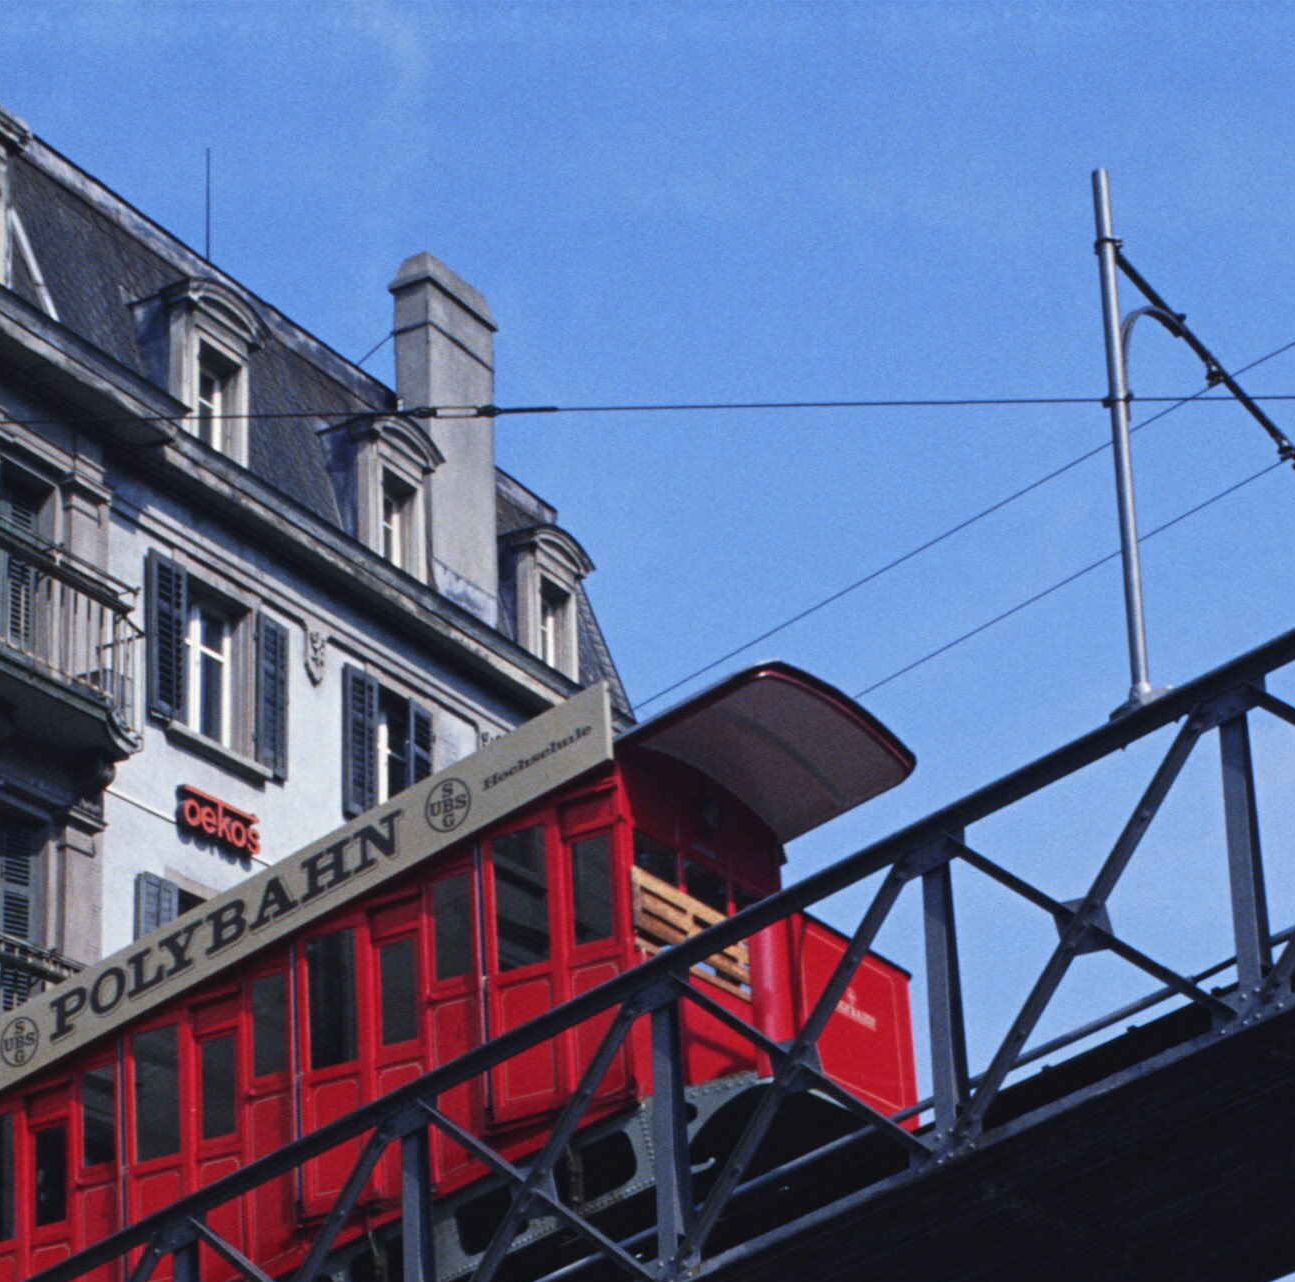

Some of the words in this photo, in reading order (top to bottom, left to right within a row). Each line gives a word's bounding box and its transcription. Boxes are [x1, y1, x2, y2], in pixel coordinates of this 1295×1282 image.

[482, 724, 592, 791] Hochschule
[183, 795, 261, 854] oekos
[49, 808, 402, 1042] POLYBAHN
